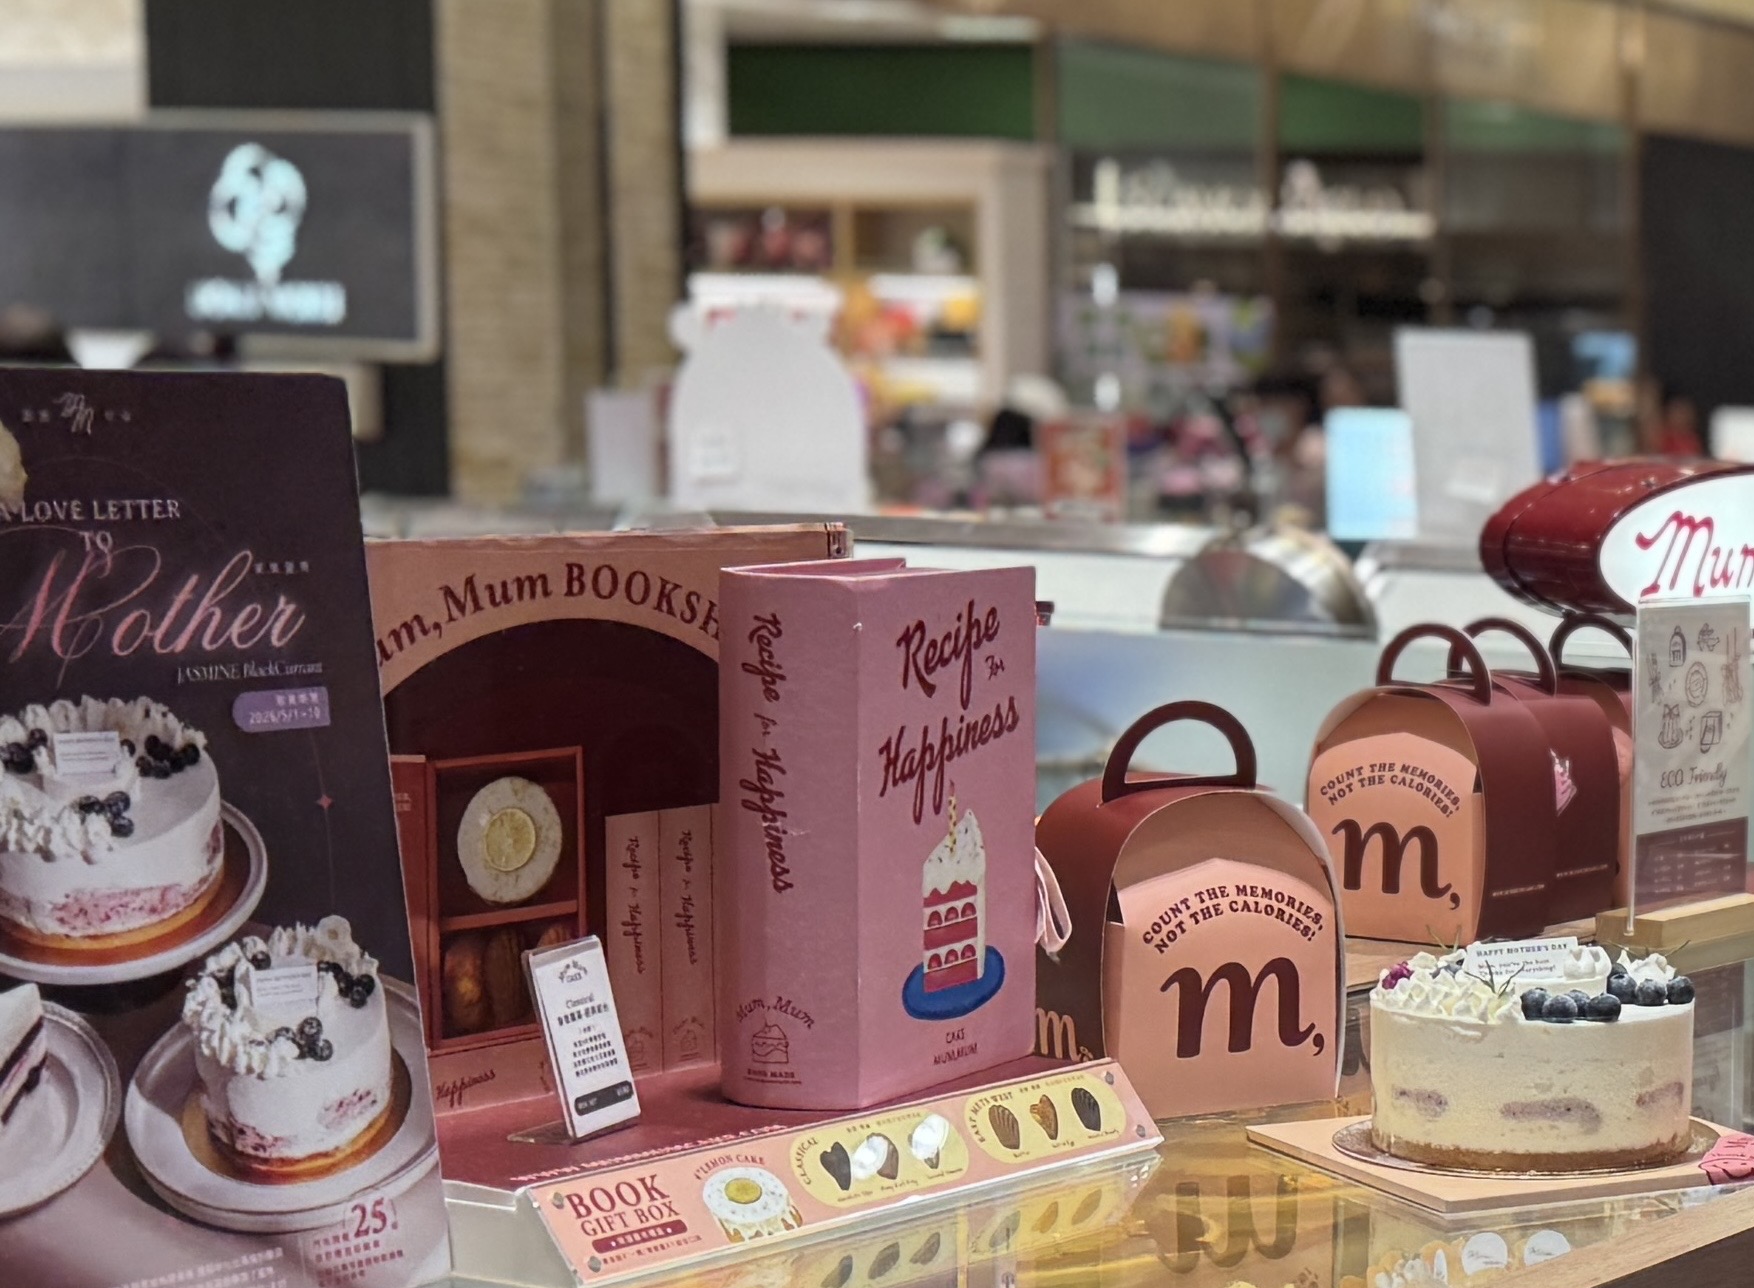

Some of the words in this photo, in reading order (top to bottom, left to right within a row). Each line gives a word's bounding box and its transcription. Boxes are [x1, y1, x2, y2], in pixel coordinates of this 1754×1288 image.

[21, 499, 85, 523] LOVE
[92, 498, 181, 521] LETTER
[80, 530, 114, 552] TO
[741, 613, 787, 704] Recipe
[896, 599, 1001, 710] Recipe
[878, 696, 1021, 825] Happiness
[1320, 766, 1364, 796] COUNT
[1369, 762, 1396, 773] THE
[1660, 768, 1685, 789] ECO
[1328, 782, 1354, 806] NOT
[1358, 775, 1386, 789] THE
[739, 747, 796, 894] Happiness
[1142, 897, 1192, 945] COUNT
[1193, 885, 1230, 904] THE
[1235, 884, 1323, 932] MEMORIES,
[1153, 920, 1188, 955] NOT
[1189, 902, 1225, 926] THE
[1229, 900, 1316, 942] CALORIES!
[1551, 943, 1568, 951] DAY
[566, 1174, 671, 1220] BOOK
[580, 1211, 630, 1238] GIFT
[636, 1200, 681, 1225] BOX
